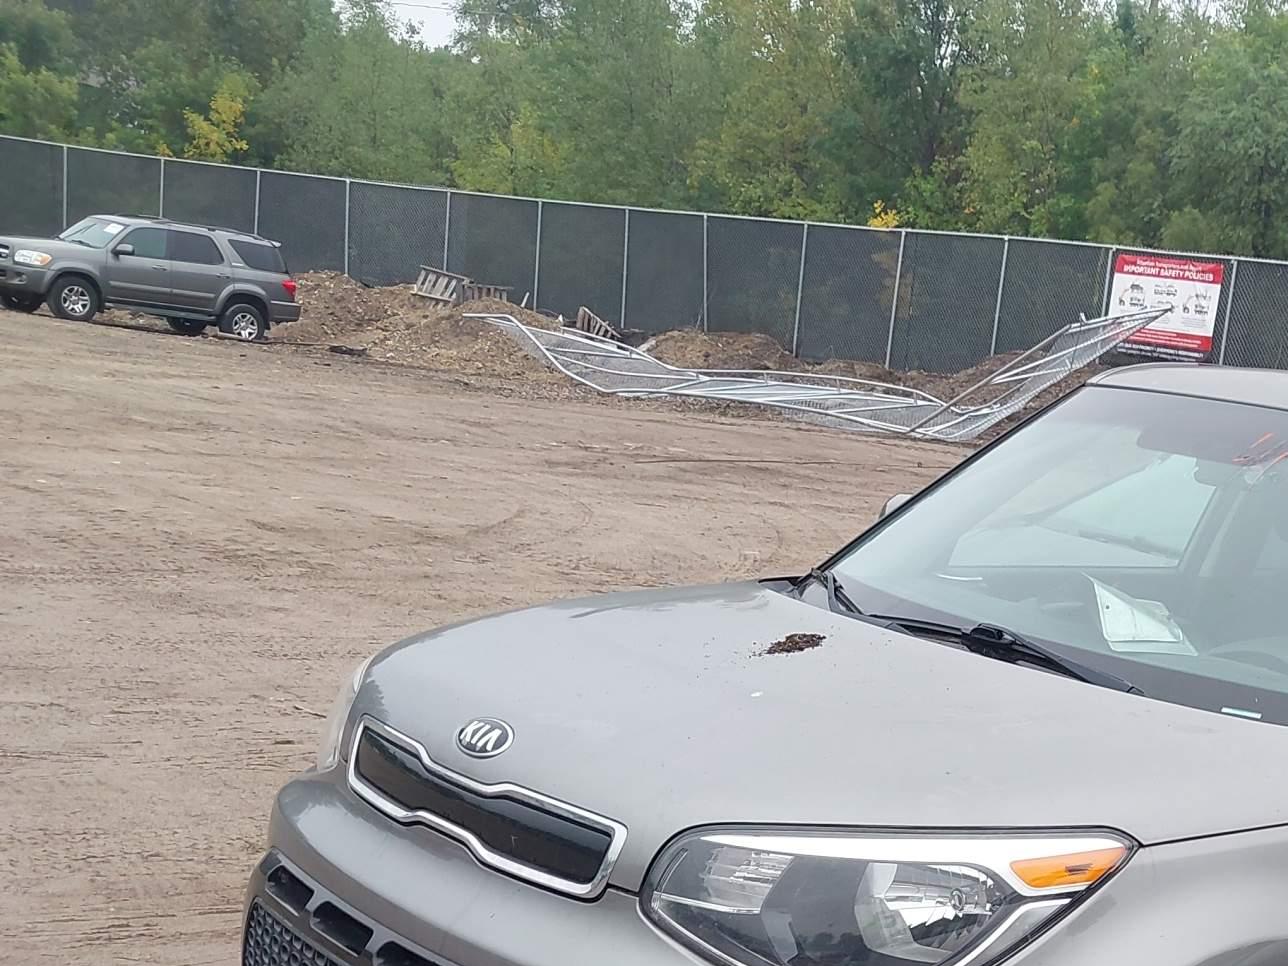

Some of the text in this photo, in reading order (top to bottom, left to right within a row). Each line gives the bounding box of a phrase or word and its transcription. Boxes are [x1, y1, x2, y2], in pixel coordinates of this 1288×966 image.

[1123, 264, 1160, 275] IMPORTANT
[1160, 269, 1185, 278] SAFETY
[1184, 271, 1214, 281] POLICIES
[459, 720, 503, 752] KIA
